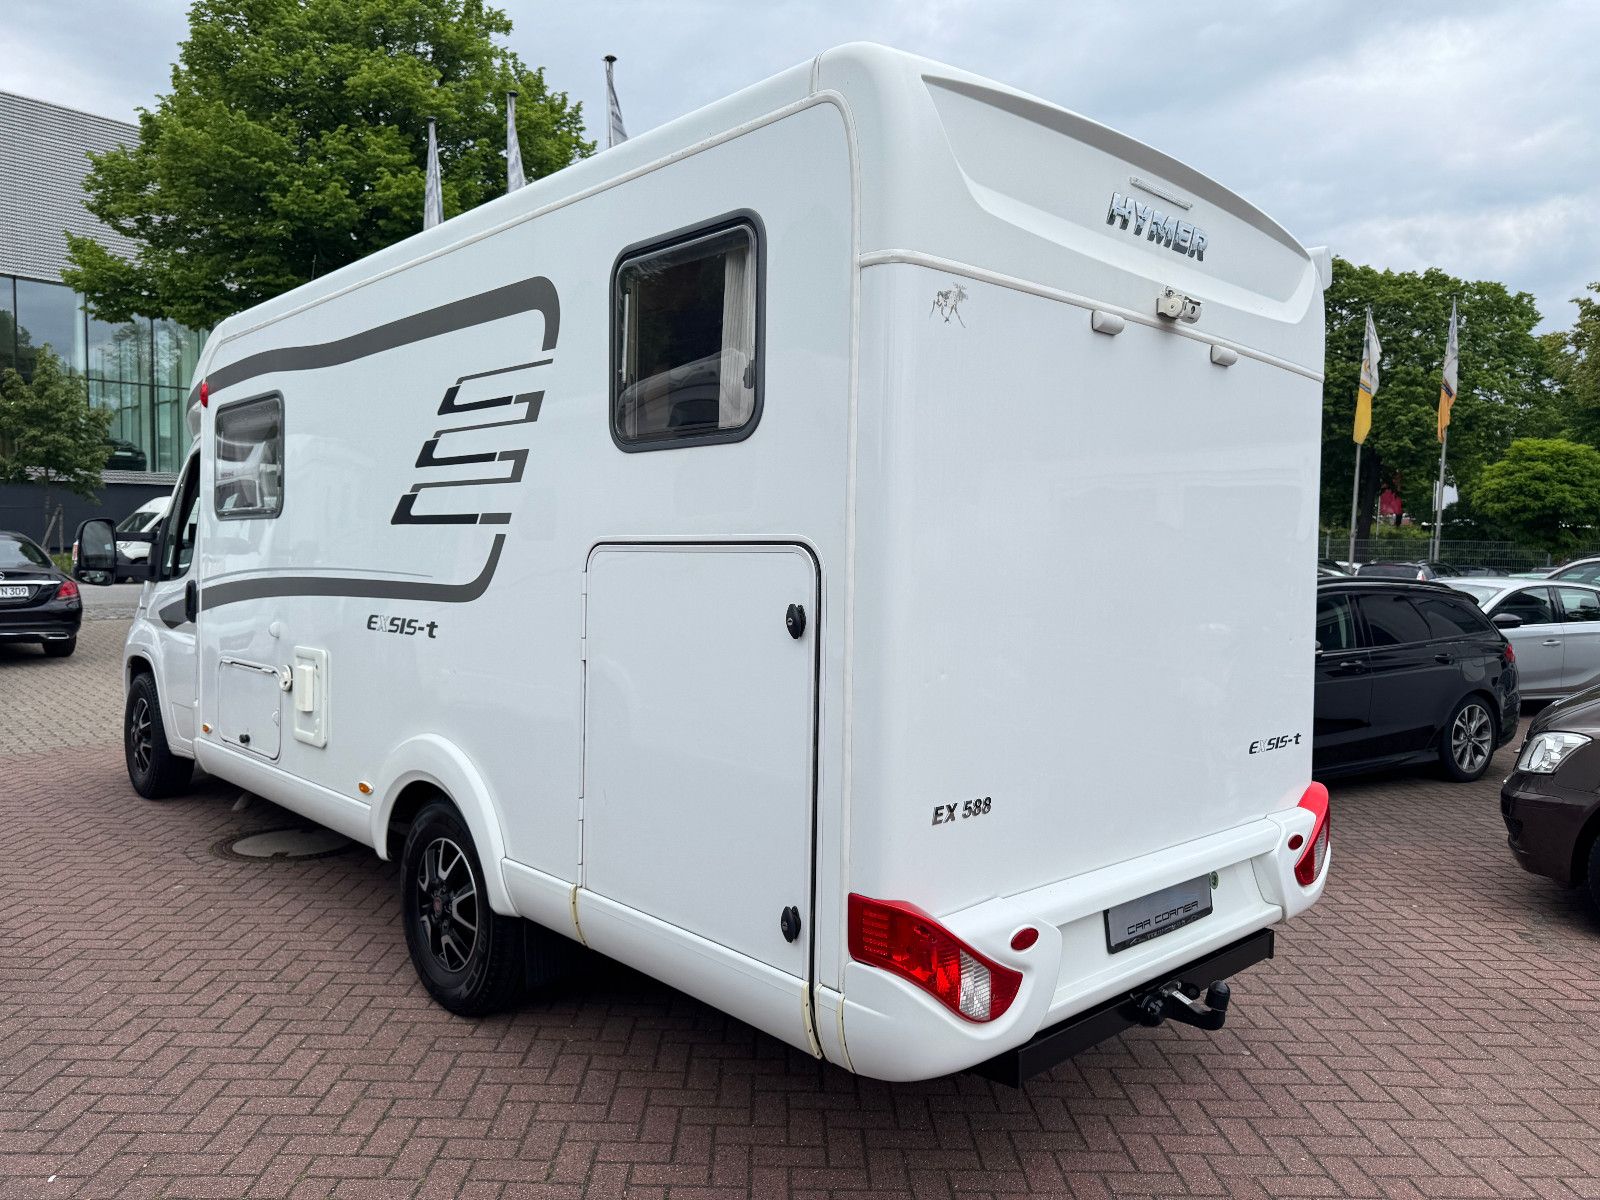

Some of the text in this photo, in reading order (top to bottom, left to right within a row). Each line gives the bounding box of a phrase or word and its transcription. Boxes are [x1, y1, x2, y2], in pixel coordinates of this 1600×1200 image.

[1106, 192, 1208, 262] HYMER
[10, 587, 26, 596] 309
[367, 614, 438, 639] EXSIS-t
[932, 797, 991, 825] EX 588
[1127, 919, 1151, 935] CAR
[1155, 900, 1199, 924] CORNER
